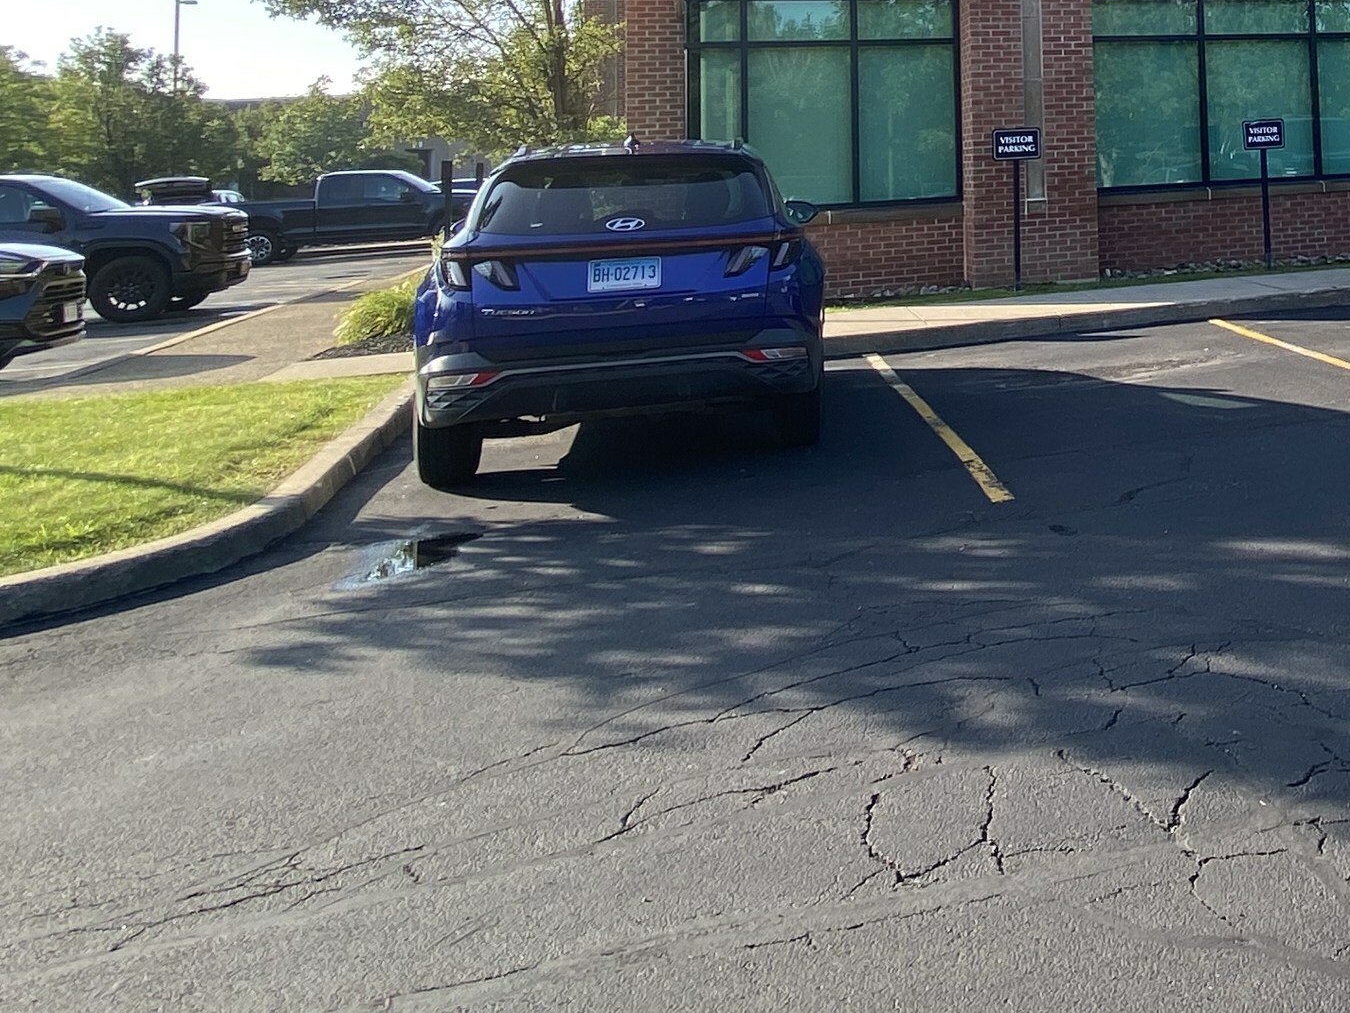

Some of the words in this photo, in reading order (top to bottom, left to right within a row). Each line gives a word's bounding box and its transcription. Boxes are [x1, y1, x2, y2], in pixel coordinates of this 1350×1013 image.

[1249, 126, 1278, 134] VISITOR
[999, 135, 1034, 144] VISITOR
[1248, 134, 1280, 143] PARKING
[998, 144, 1036, 154] PARKING
